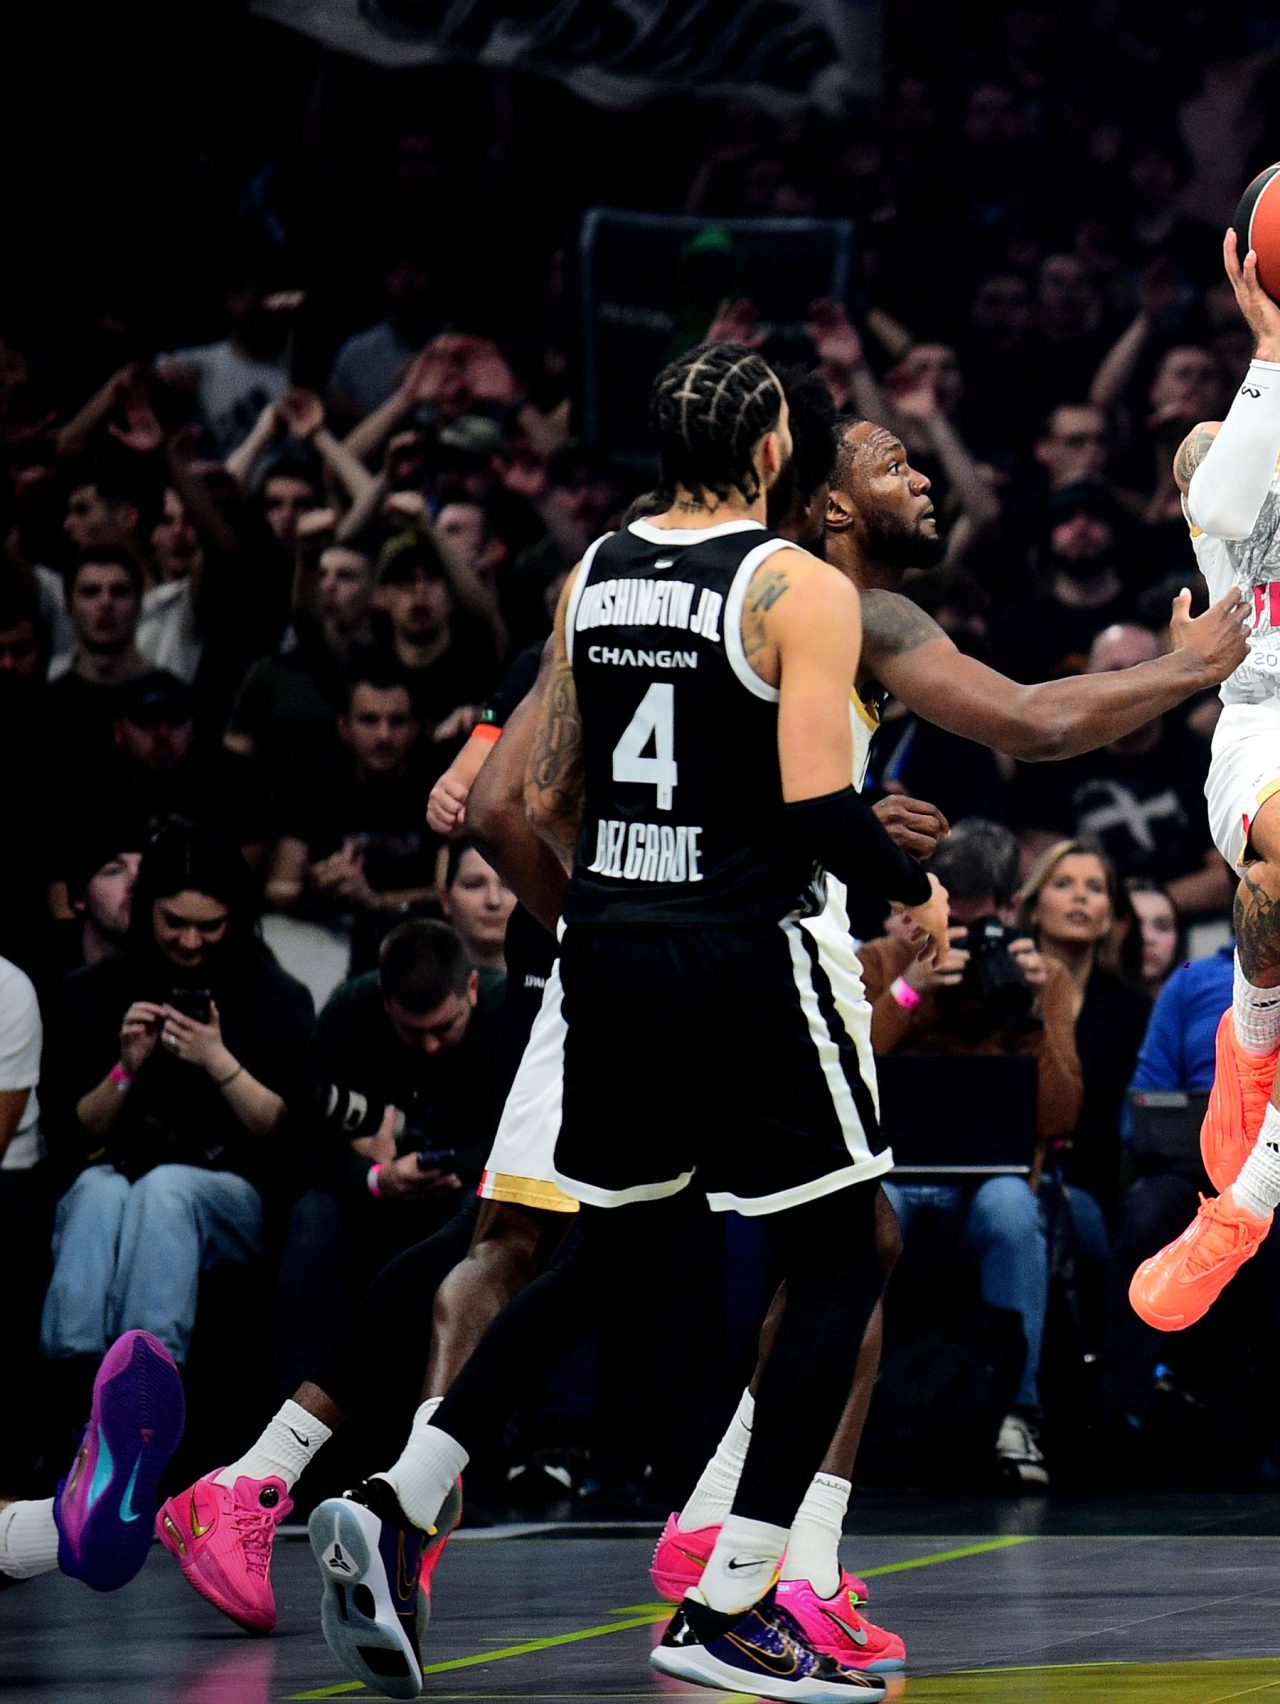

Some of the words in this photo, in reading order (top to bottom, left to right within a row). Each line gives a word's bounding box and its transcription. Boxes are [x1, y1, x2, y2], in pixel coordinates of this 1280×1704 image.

[588, 646, 698, 669] CHANGAN
[612, 682, 678, 811] 4
[588, 819, 703, 882] BELGRADE
